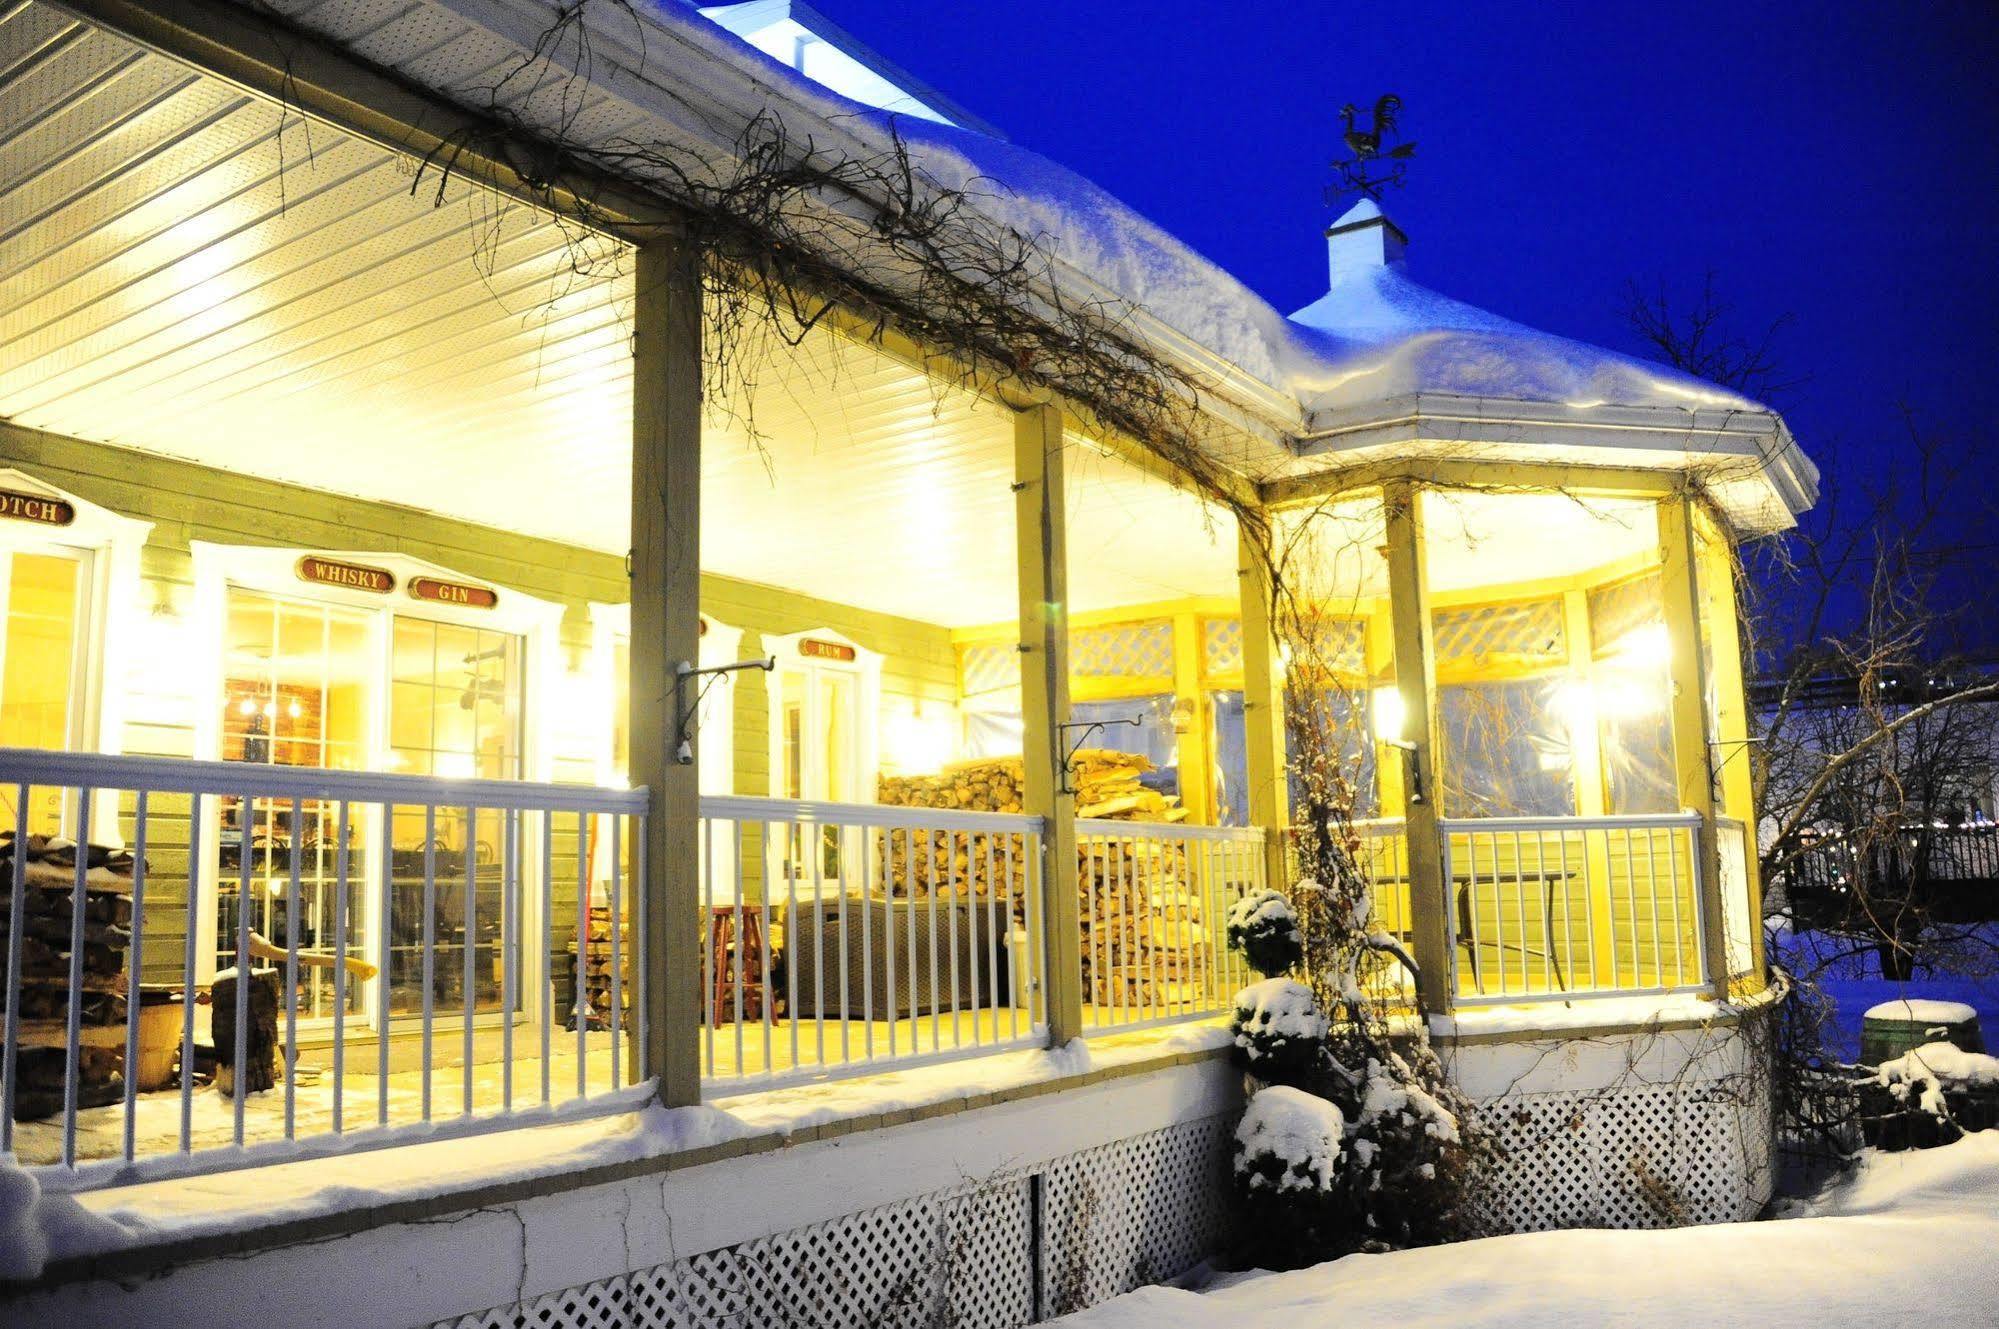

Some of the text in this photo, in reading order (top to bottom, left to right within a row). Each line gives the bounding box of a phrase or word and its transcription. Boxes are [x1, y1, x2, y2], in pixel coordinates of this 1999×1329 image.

[315, 562, 381, 588] WHISKY
[438, 585, 469, 603] GIN
[818, 643, 841, 659] RUM
